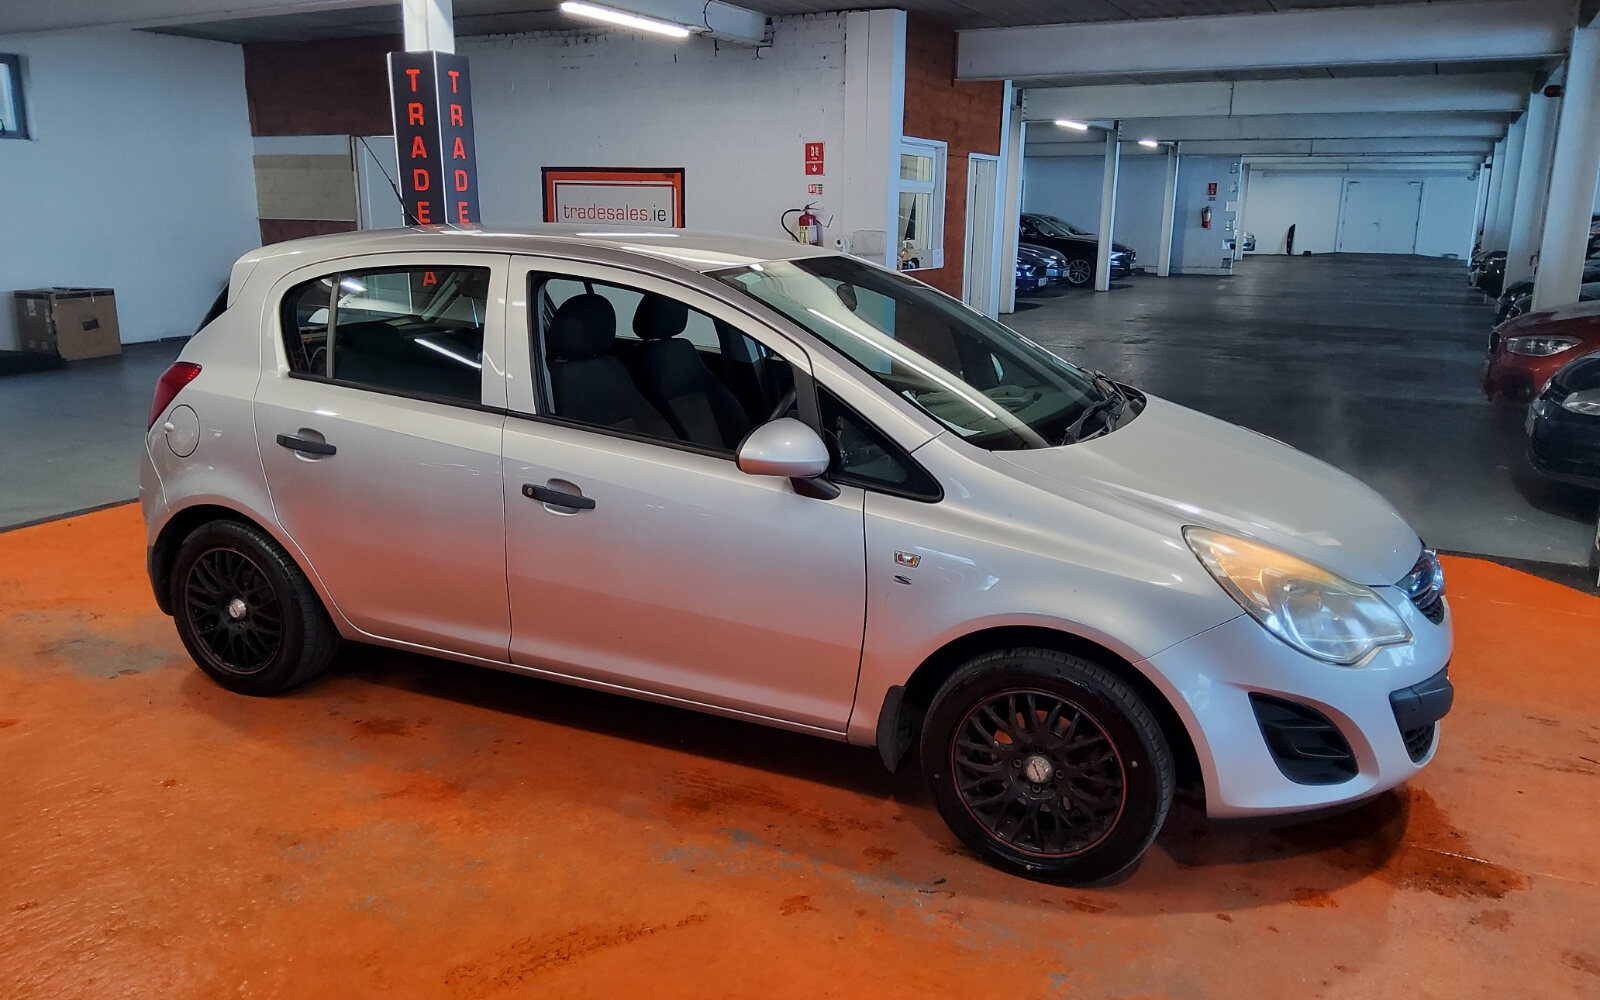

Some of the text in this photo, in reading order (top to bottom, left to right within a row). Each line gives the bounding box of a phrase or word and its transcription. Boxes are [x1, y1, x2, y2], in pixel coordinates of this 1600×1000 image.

[406, 69, 431, 223] TRADE
[448, 70, 469, 223] TRADE
[563, 203, 667, 222] tradesales.ie
